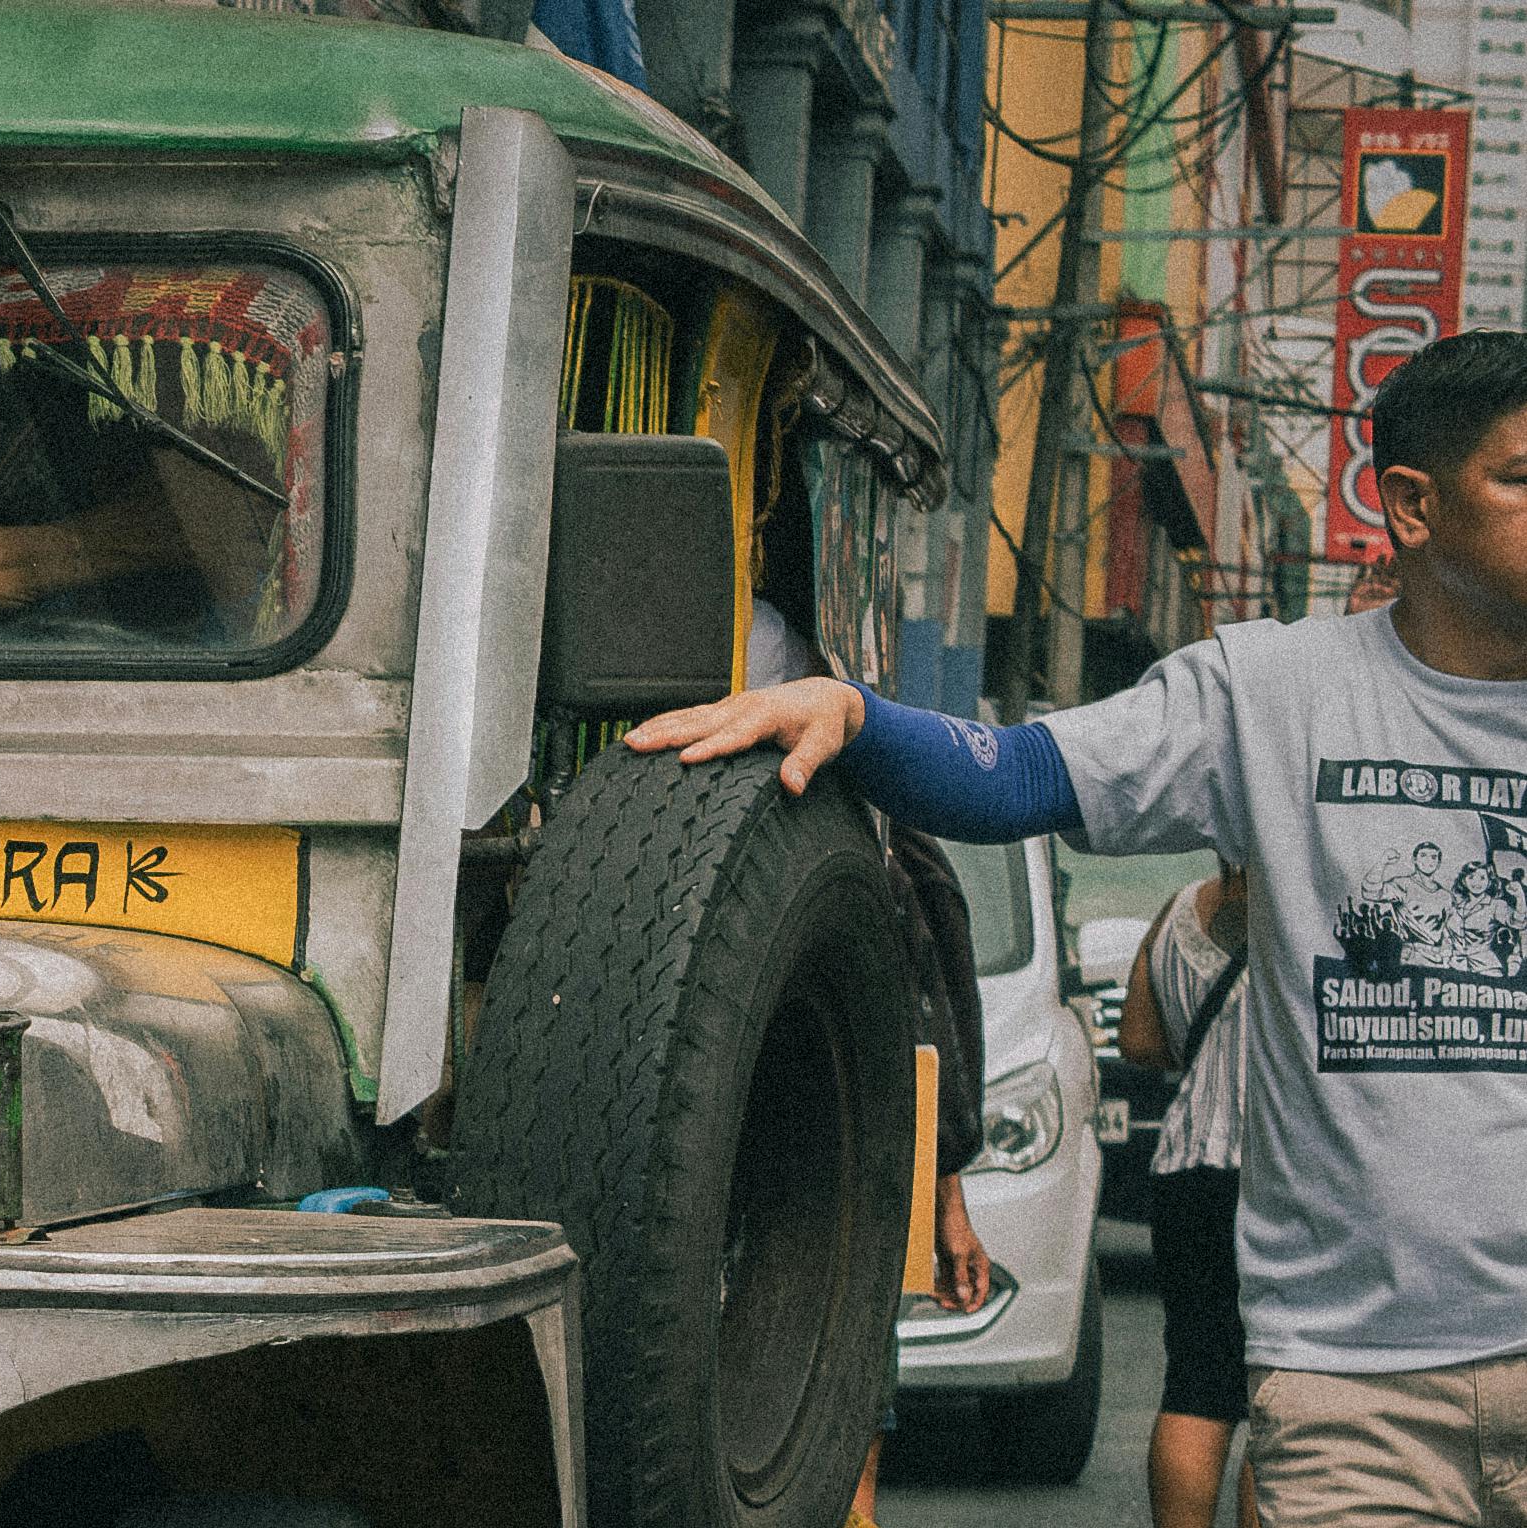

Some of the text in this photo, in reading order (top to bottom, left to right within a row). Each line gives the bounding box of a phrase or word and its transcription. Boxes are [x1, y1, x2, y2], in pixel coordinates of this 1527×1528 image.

[1470, 777, 1527, 808] DAY
[1324, 1012, 1486, 1044] Unyunismo,
[1324, 1045, 1347, 1060] Para
